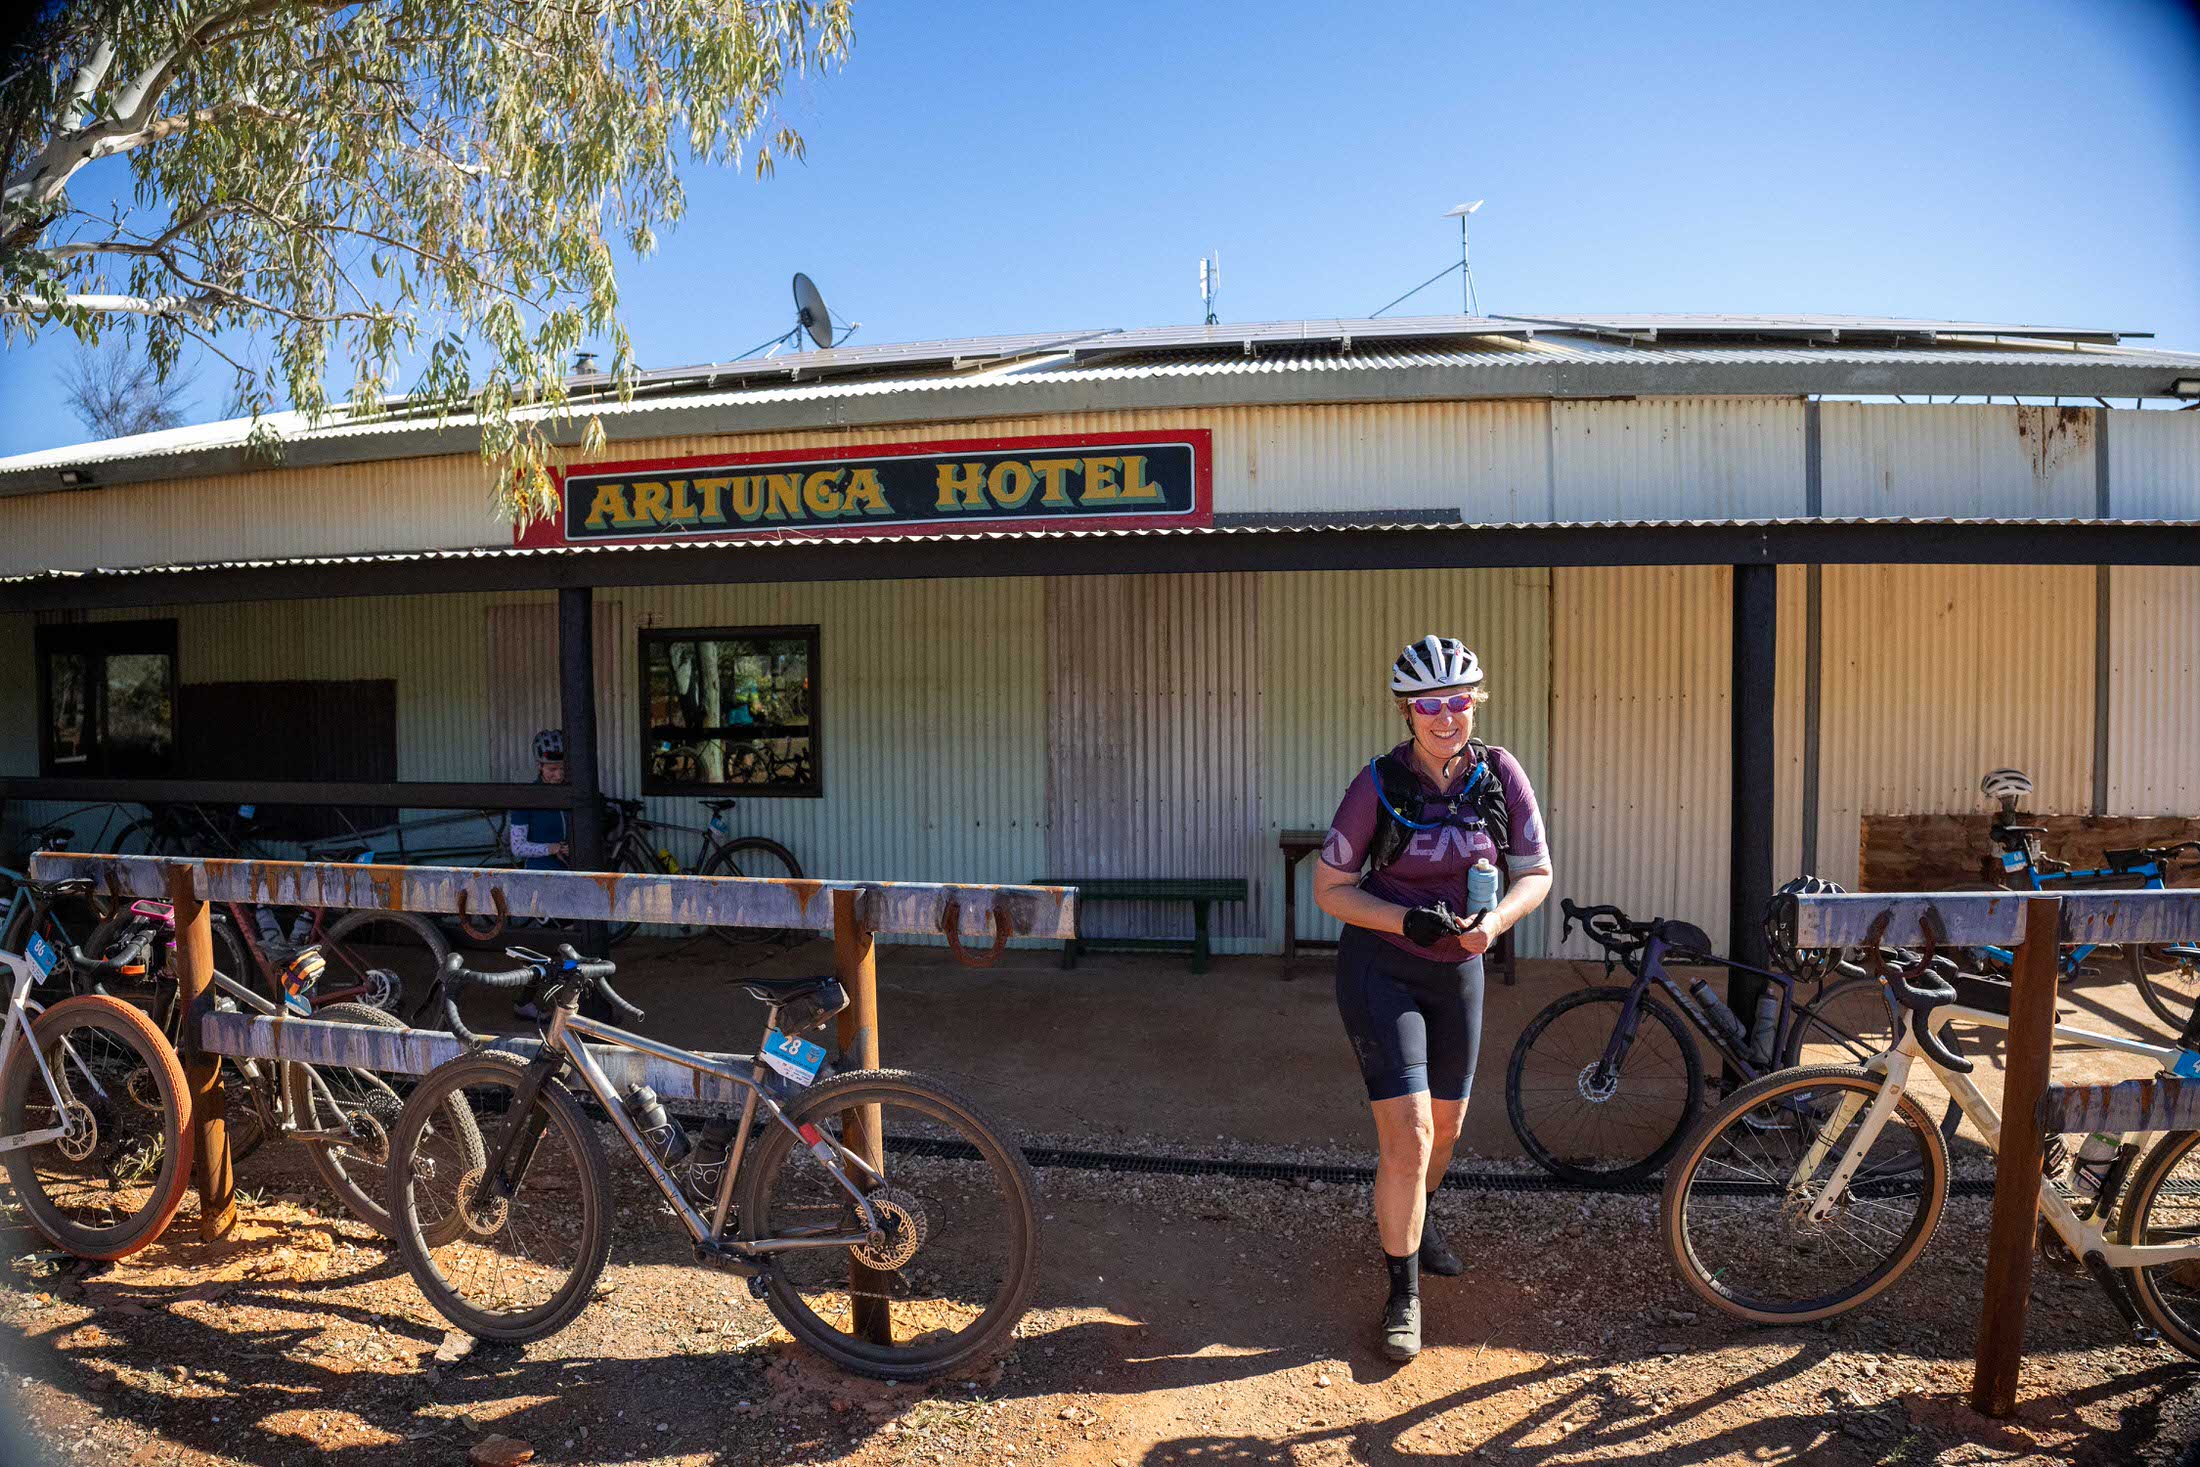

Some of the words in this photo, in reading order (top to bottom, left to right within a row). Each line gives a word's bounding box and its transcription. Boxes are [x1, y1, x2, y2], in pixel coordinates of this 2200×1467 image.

[584, 467, 895, 530] ARLTUNGA
[935, 455, 1166, 512] HOTEL
[778, 1035, 802, 1055] 28
